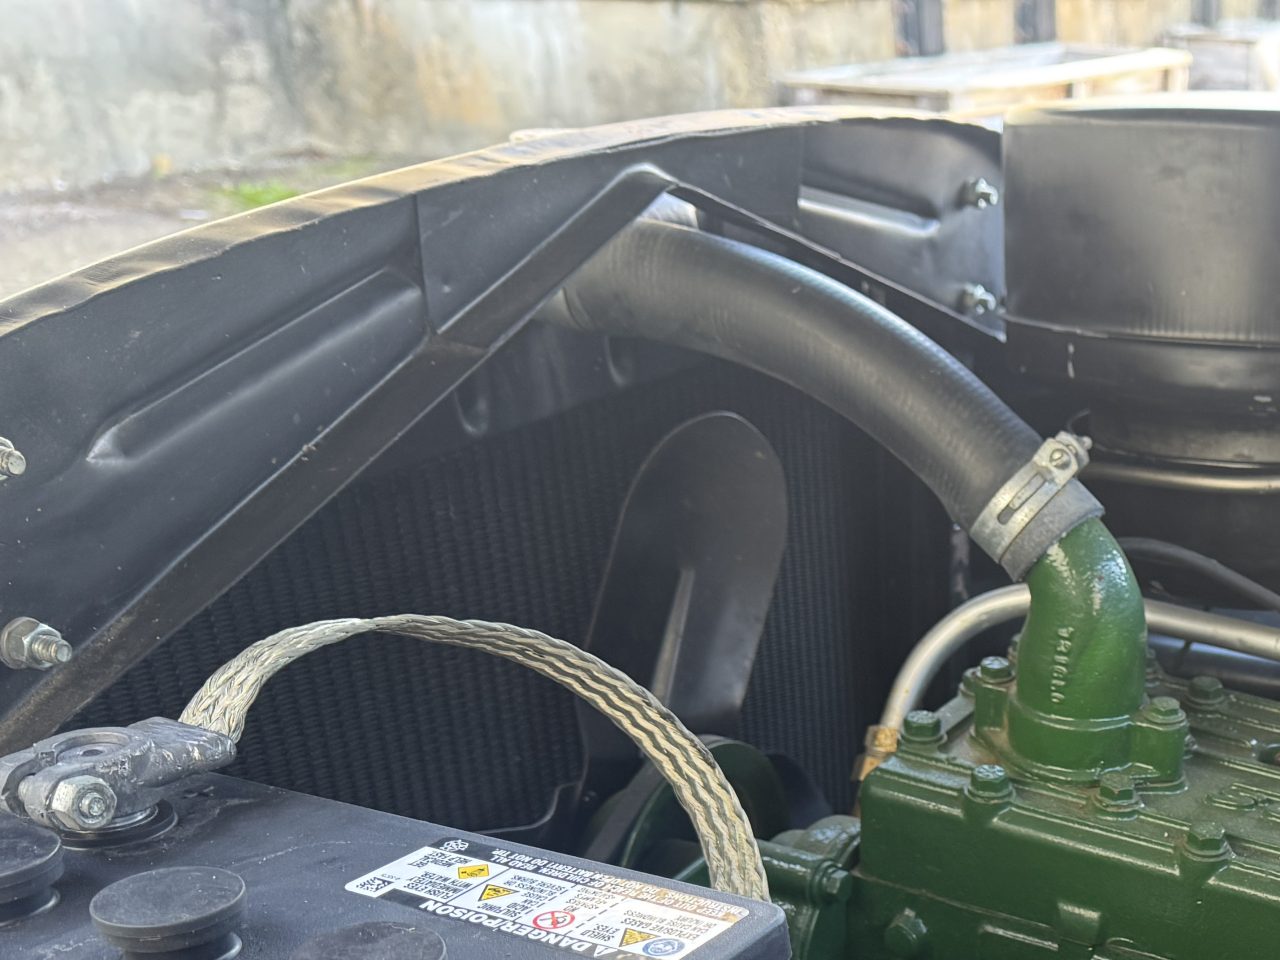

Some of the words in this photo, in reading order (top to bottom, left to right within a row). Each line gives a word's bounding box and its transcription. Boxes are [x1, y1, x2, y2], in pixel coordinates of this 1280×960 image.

[489, 854, 511, 863] ALL
[508, 853, 532, 862] NOT
[508, 860, 537, 870] READ
[592, 873, 621, 884] OPEN
[403, 882, 428, 891] EYES
[408, 876, 462, 893] IMMEDIATELY
[449, 880, 472, 888] WITH
[536, 881, 565, 891] SEVERE
[618, 880, 644, 889] NOT
[424, 888, 453, 899] FLUSH
[515, 883, 556, 896] BLINDNESS
[602, 883, 640, 896] REACH
[520, 891, 547, 901] CAUSE
[506, 902, 530, 911] ACID
[521, 898, 539, 906] CAN
[673, 901, 697, 910] OUT
[477, 903, 520, 917] SULFURIC
[696, 907, 726, 917] KEEP
[421, 900, 595, 951] DANGER/POISON
[620, 917, 652, 928] GASES
[580, 929, 614, 941] SHIELD
[649, 924, 699, 939] EXPLOSIVE
